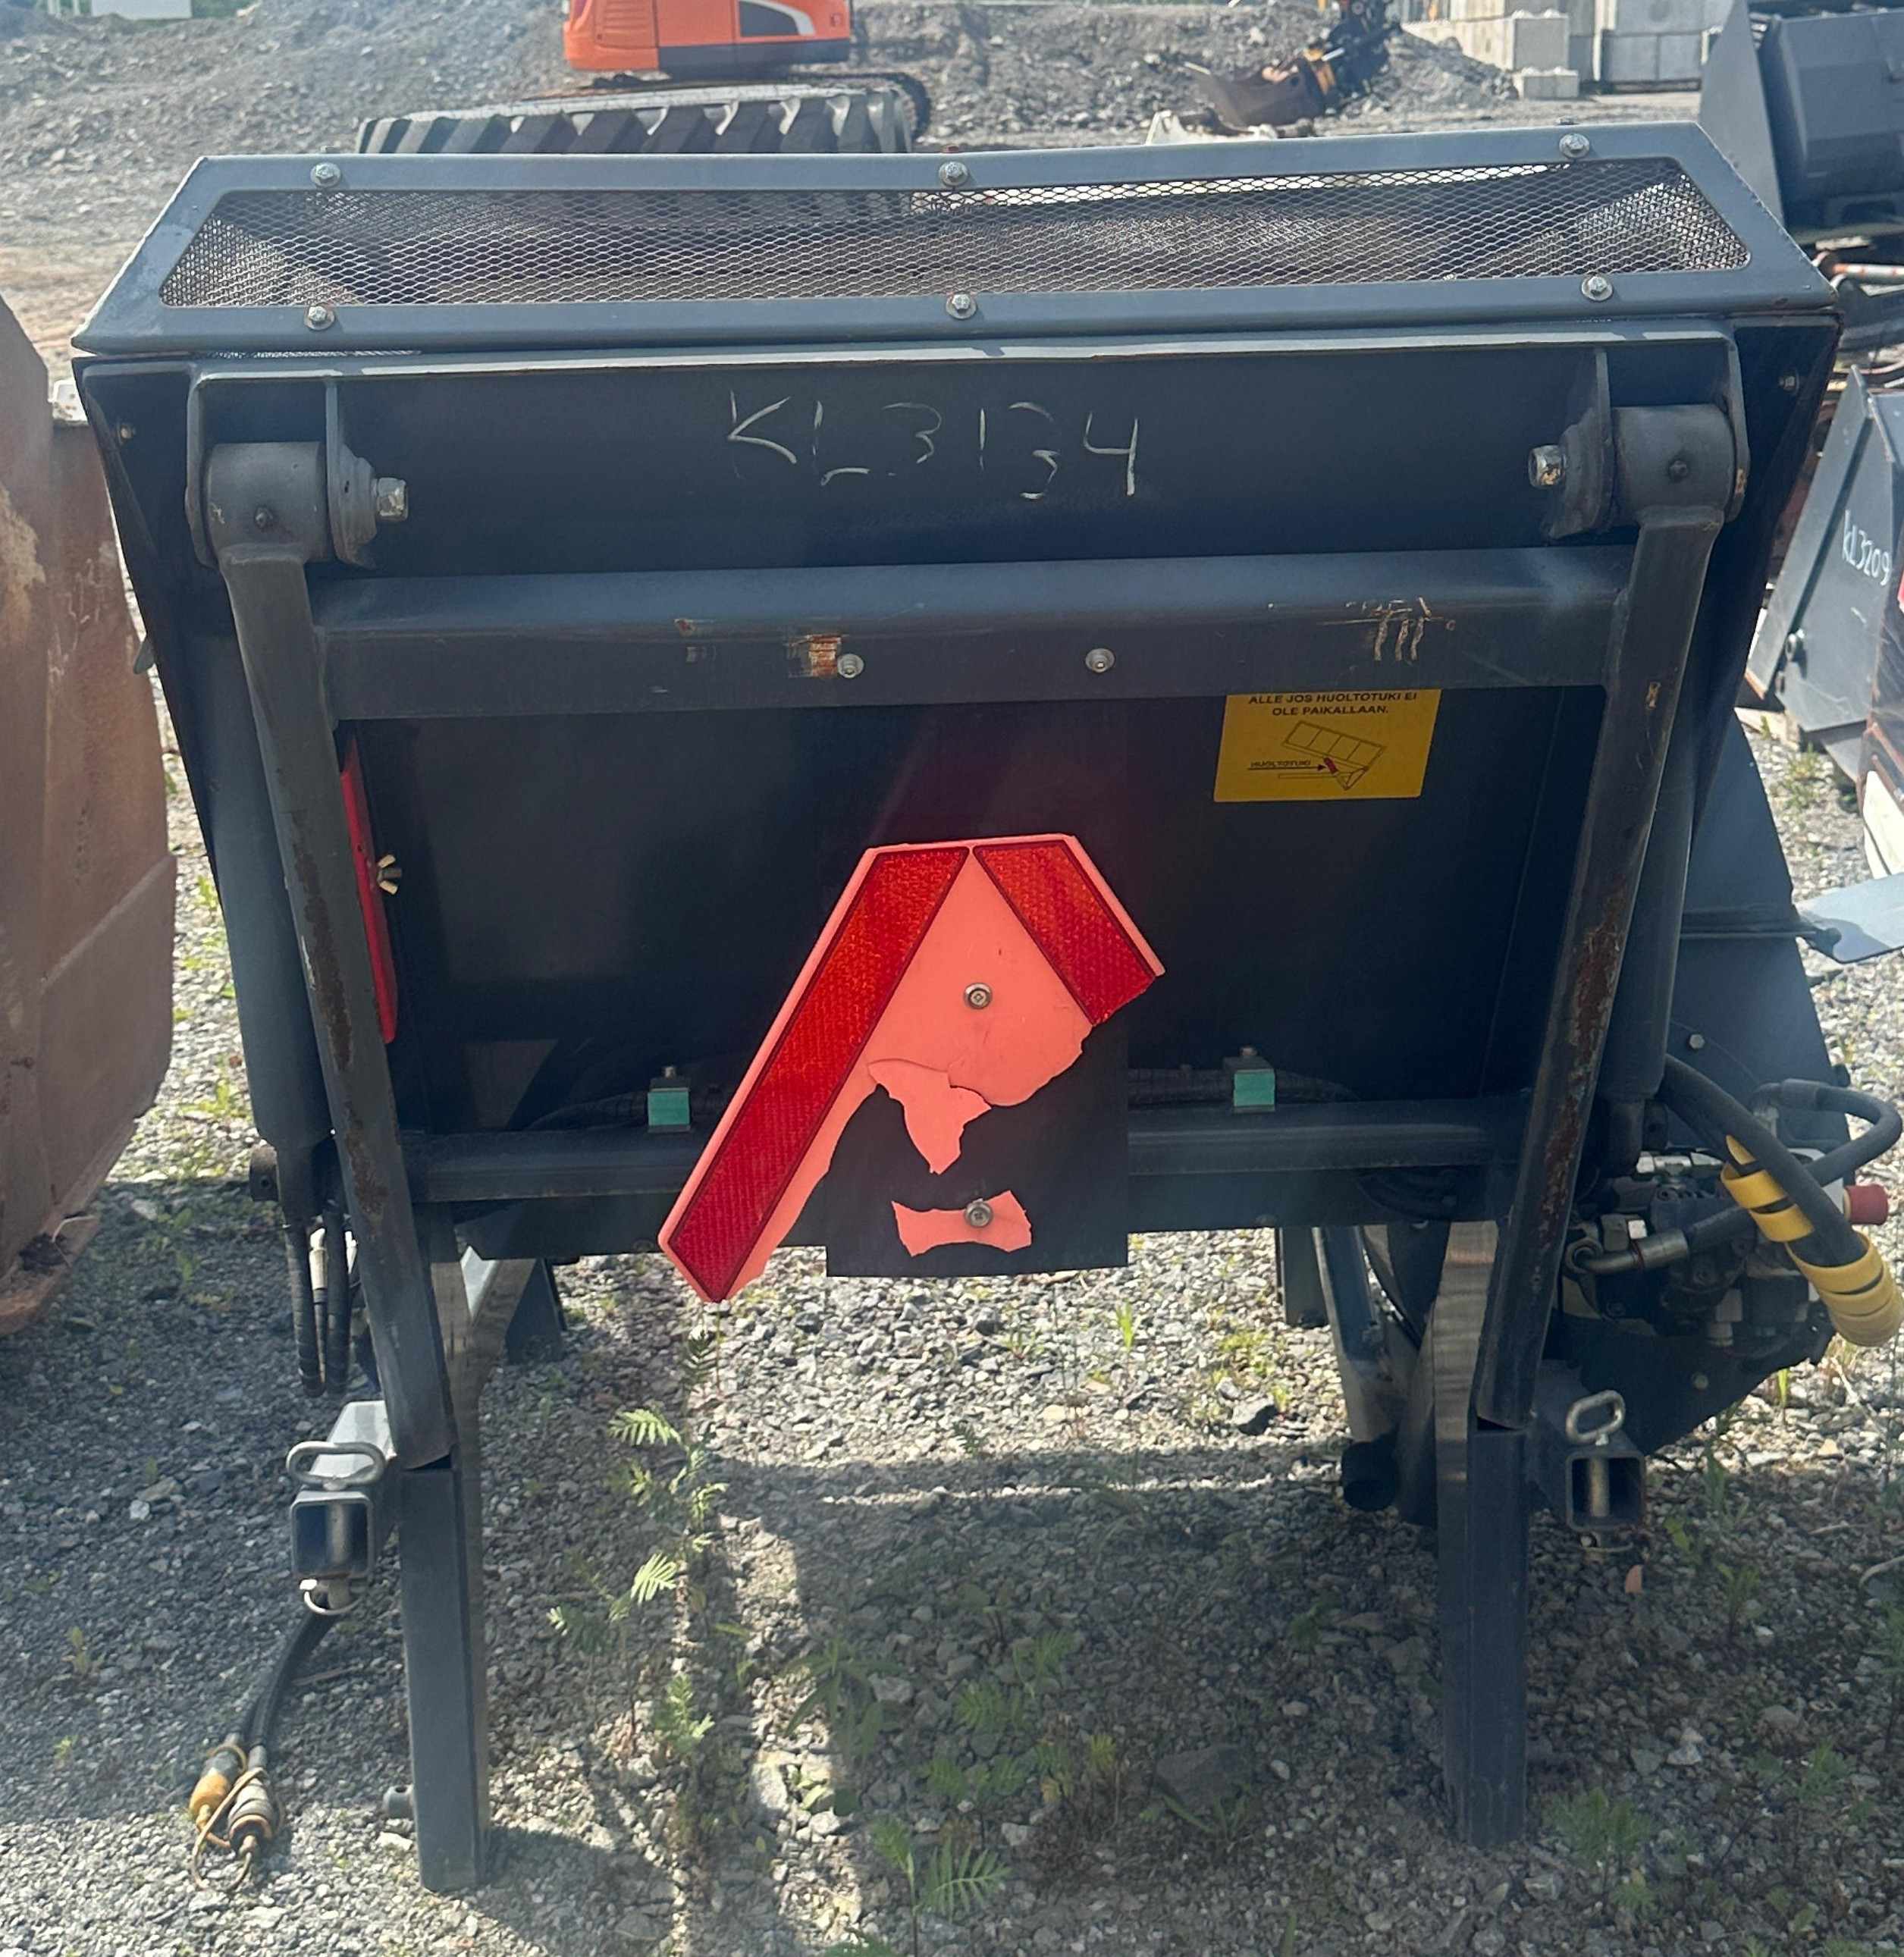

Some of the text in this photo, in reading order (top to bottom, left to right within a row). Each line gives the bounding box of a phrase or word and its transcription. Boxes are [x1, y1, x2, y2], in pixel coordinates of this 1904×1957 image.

[1248, 691, 1417, 704] ALLE JOS HUOLTOTUKI EI
[1272, 705, 1389, 716] OLE PAIKALLAAN.
